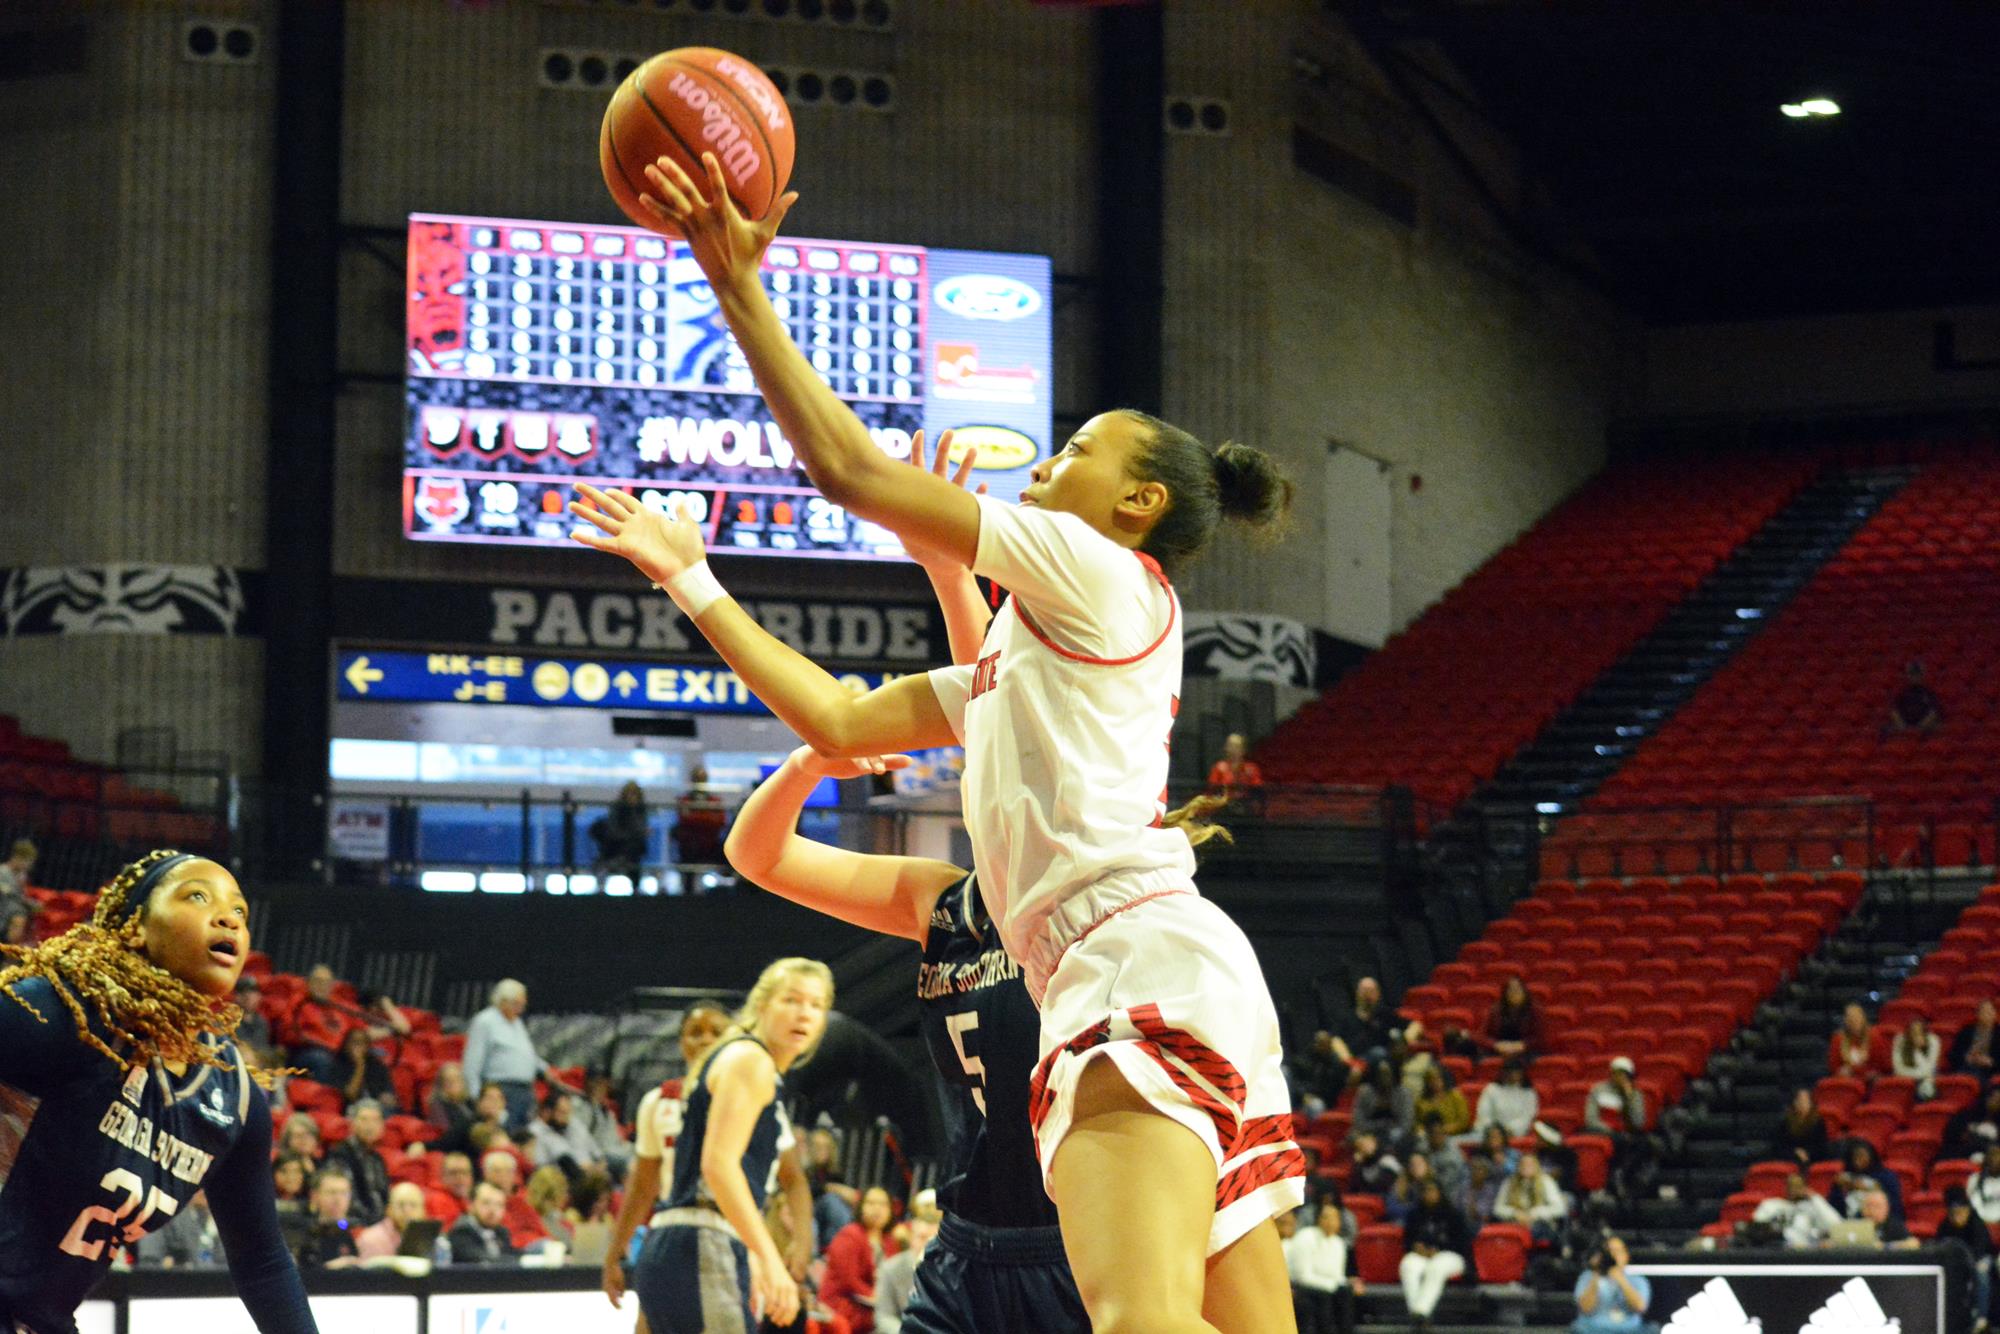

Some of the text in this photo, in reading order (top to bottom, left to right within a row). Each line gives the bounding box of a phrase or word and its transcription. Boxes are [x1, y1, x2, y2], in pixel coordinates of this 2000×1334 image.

[669, 72, 760, 187] Wilson
[599, 260, 612, 281] 1
[473, 278, 487, 301] 1
[557, 284, 570, 305] 1
[599, 286, 612, 308] 1
[855, 276, 868, 297] 1
[855, 303, 868, 324] 1
[641, 314, 654, 336] 1
[557, 334, 570, 356] 1
[854, 378, 869, 400] 1
[491, 590, 929, 659] PACK RIDE
[646, 668, 749, 704] EXIT
[945, 1010, 987, 1118] 5
